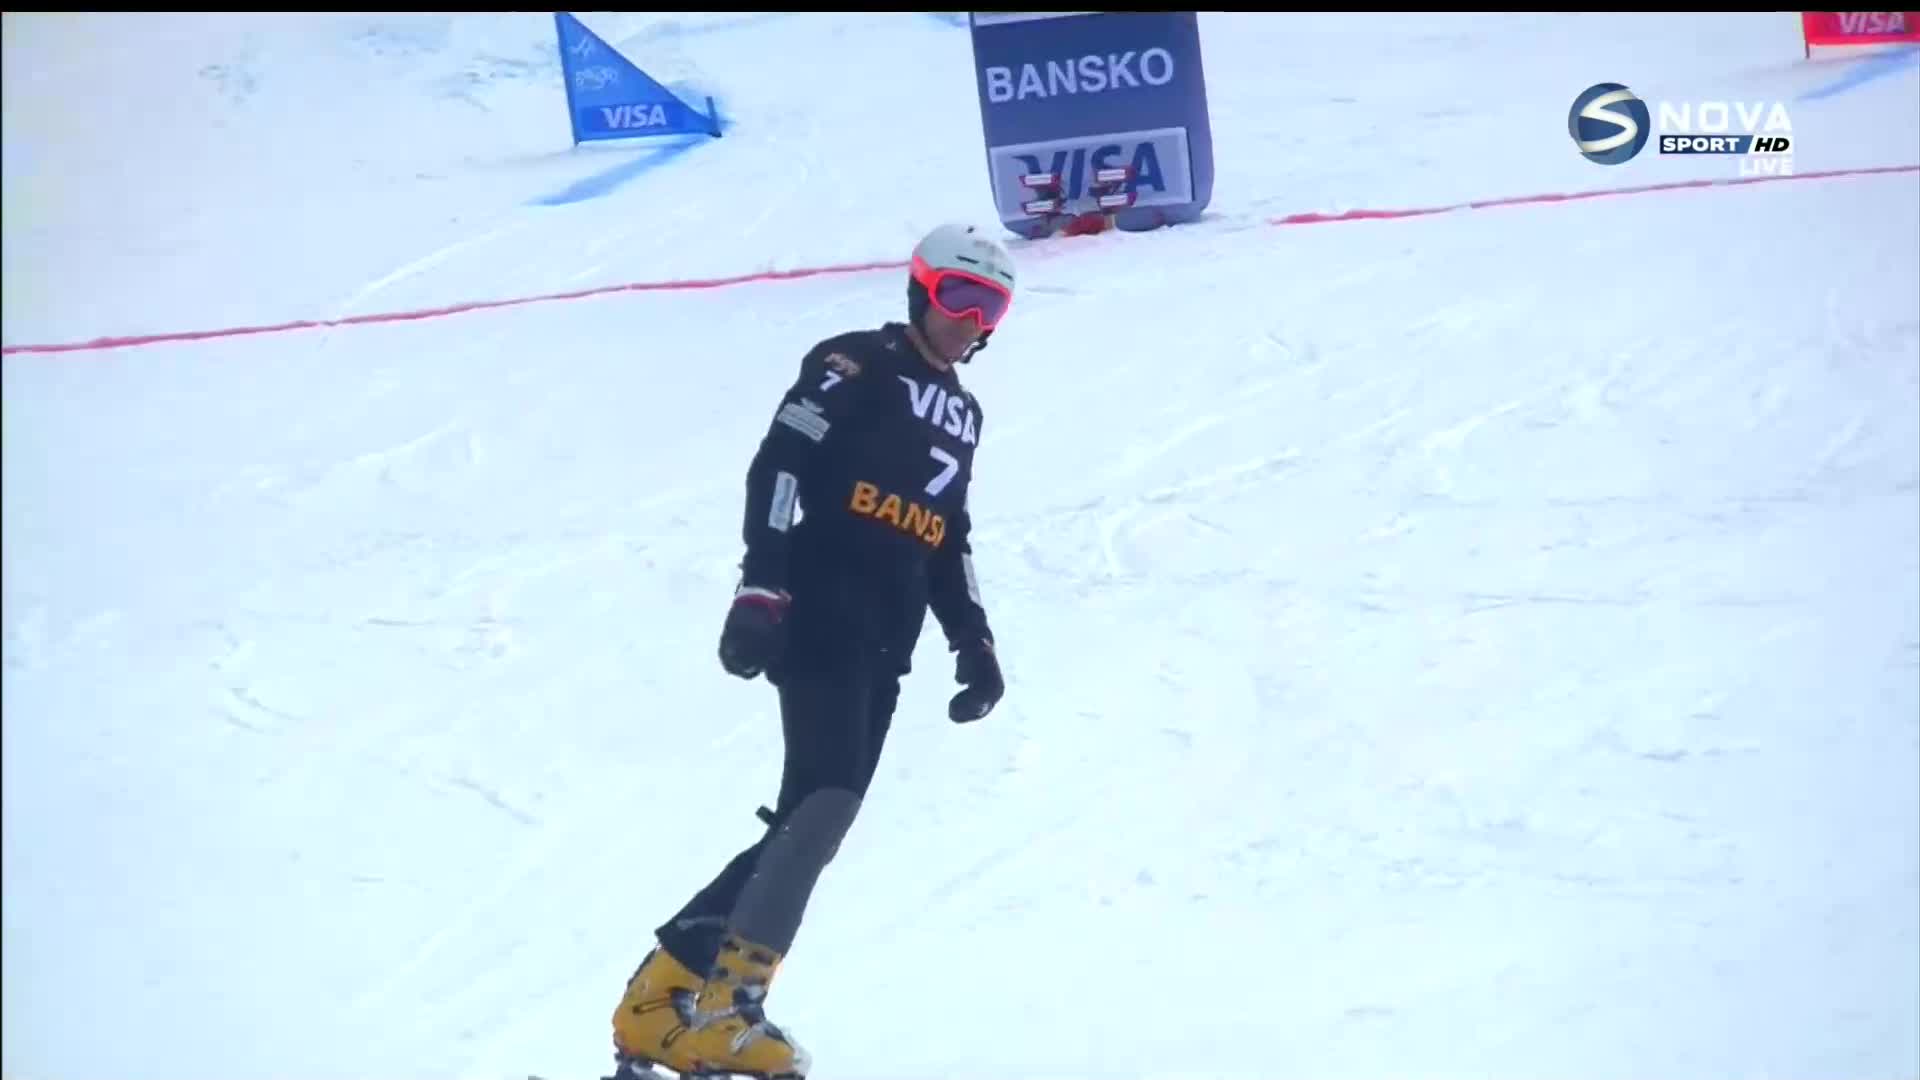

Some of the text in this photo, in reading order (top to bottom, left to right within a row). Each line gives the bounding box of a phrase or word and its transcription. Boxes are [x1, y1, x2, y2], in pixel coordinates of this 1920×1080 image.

[986, 47, 1174, 103] BANSKO
[601, 103, 667, 129] VISA
[819, 371, 844, 392] 7
[898, 375, 977, 446] VISA
[923, 446, 960, 497] 7
